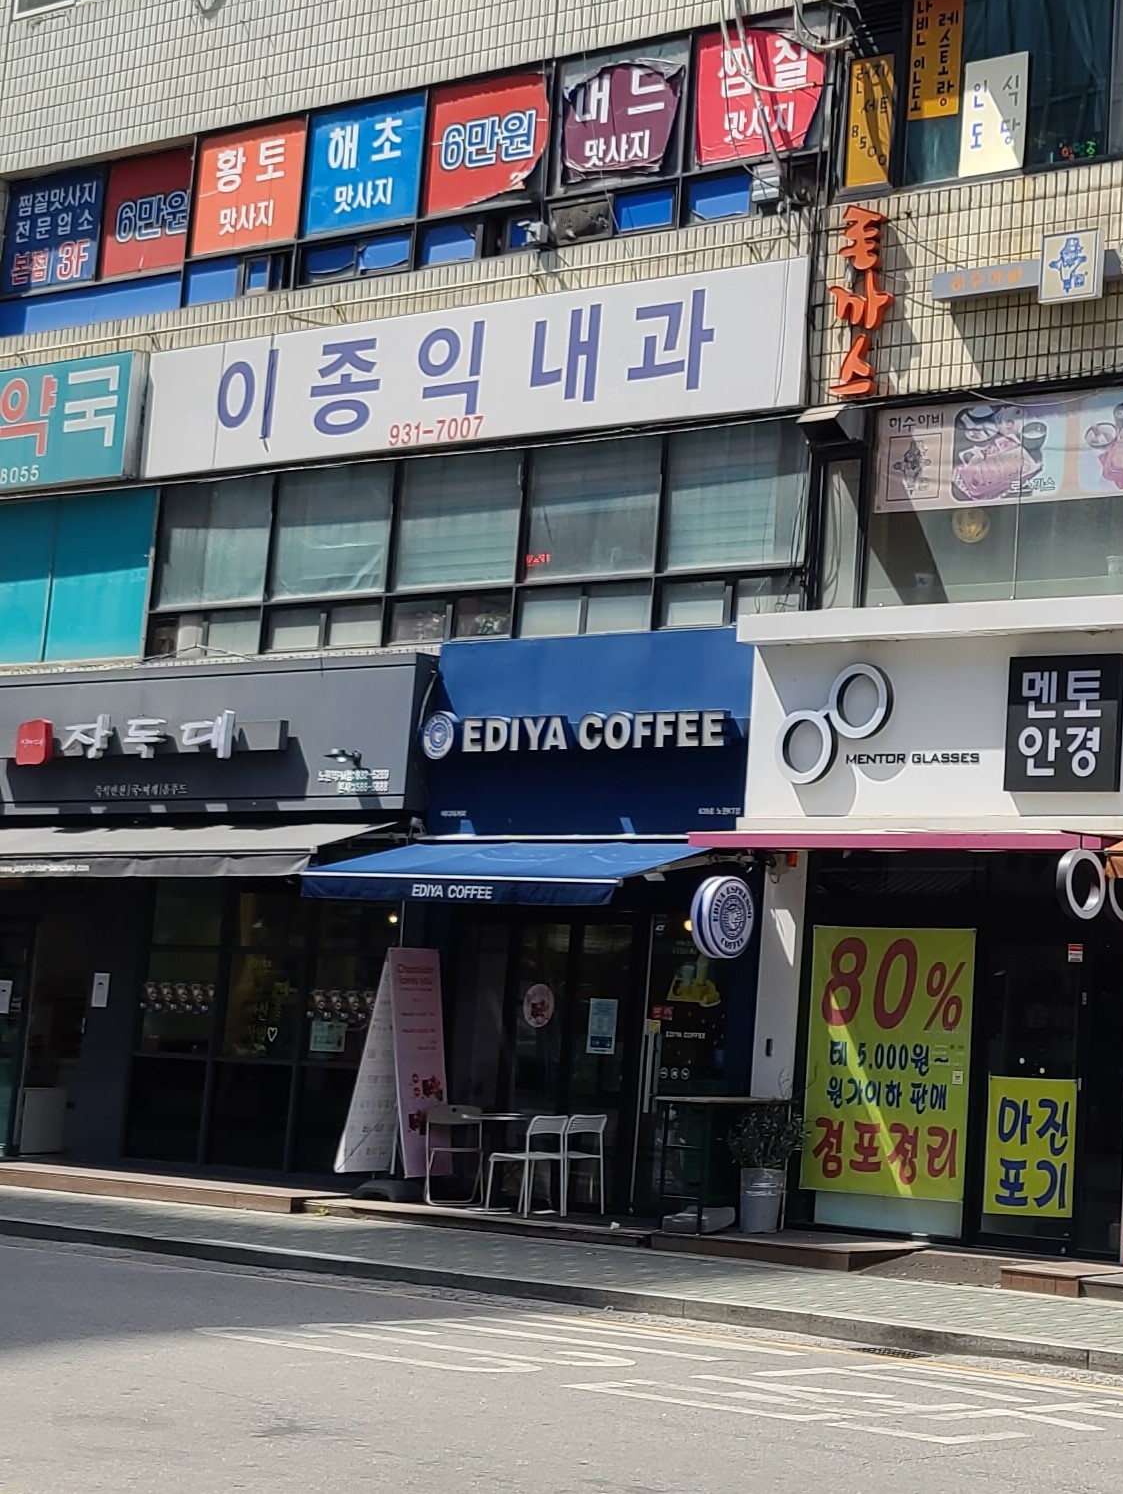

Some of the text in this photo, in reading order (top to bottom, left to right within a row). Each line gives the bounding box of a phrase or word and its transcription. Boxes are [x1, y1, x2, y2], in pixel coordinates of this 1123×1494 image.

[936, 10, 959, 107] 레스토랑
[723, 102, 794, 143] 맛사지
[970, 79, 988, 150] 인도
[1000, 74, 1021, 145] 식당
[328, 117, 403, 170] 해초
[441, 109, 536, 172] 6만원
[584, 130, 650, 168] 맛사지
[851, 125, 887, 166] 8500
[215, 137, 286, 193] 황토
[18, 180, 97, 217] 찜질맛사지
[116, 189, 190, 243] 6만원
[218, 199, 274, 235] 맛사지
[334, 177, 393, 215] 맛사지
[15, 209, 94, 243] 전문업소
[56, 239, 91, 281] 3F
[0, 364, 121, 457] 약국
[388, 415, 484, 447] 931-7007
[1022, 670, 1102, 719] 멘토
[61, 710, 237, 760] 장독대
[462, 715, 568, 753] EDIYA
[578, 711, 726, 750] COFFEE
[1018, 726, 1100, 778] 안경
[845, 752, 981, 765] MENTOR GLASSES
[411, 884, 493, 900] EDIYA COFFEE
[821, 936, 967, 1031] 80%
[829, 1040, 847, 1067] 테
[827, 1076, 947, 1114] 원가이하 판매
[812, 1116, 957, 1186] 점포정리
[995, 1158, 1068, 1210] 포기
